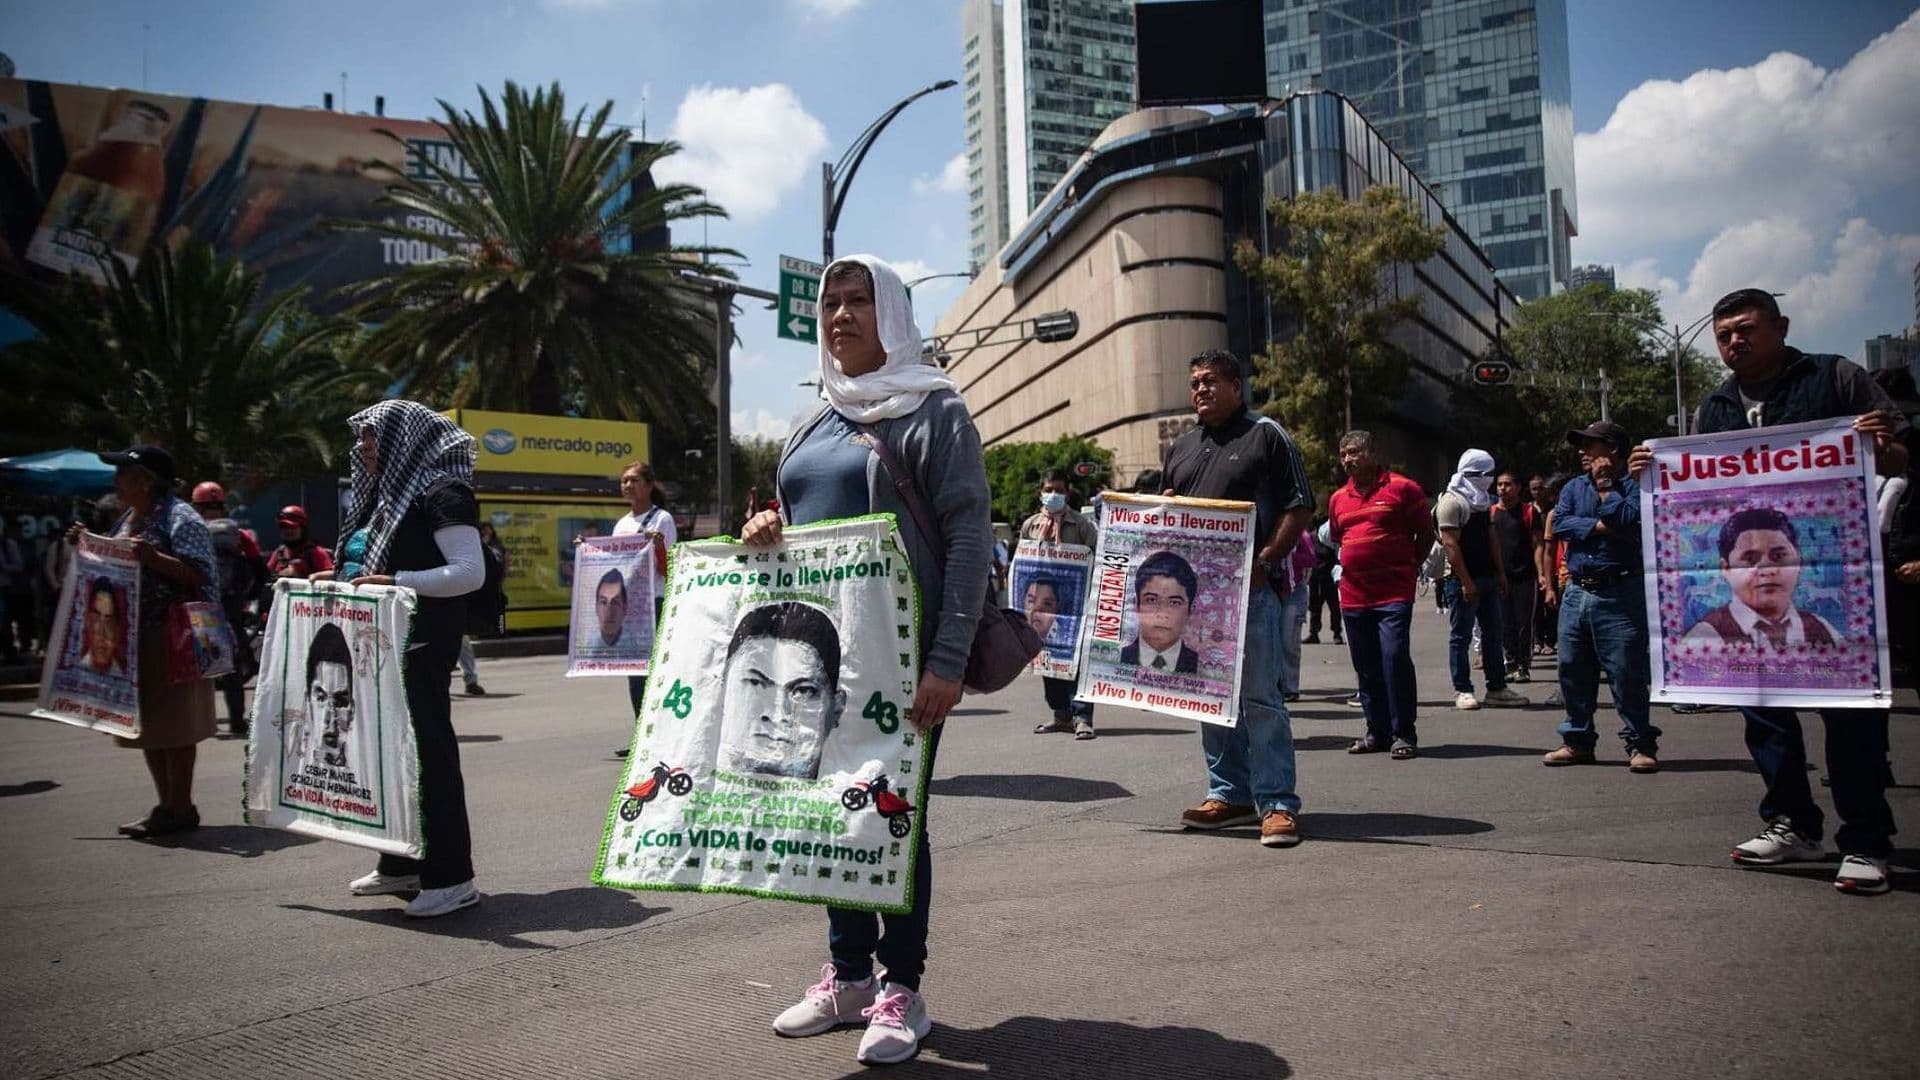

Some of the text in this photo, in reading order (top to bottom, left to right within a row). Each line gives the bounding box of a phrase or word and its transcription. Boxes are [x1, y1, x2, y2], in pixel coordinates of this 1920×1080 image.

[521, 435, 632, 458] mercado pago
[1659, 434, 1857, 490] ¡Justicia!
[1110, 507, 1245, 533] ¡Vivo se lo llevaron!
[1048, 547, 1088, 561] llevaron!
[686, 557, 892, 592] ¡Vivo se lo llevaron!
[1099, 568, 1125, 612] FALTAN
[1095, 614, 1121, 640] NOS
[662, 679, 693, 720] 43
[862, 690, 900, 734] 43
[1092, 681, 1126, 699] ¡Vivo
[1130, 686, 1143, 701] lo
[1147, 692, 1223, 716] queremos!
[635, 829, 884, 864] ¡Con VIDA lo queremos!
